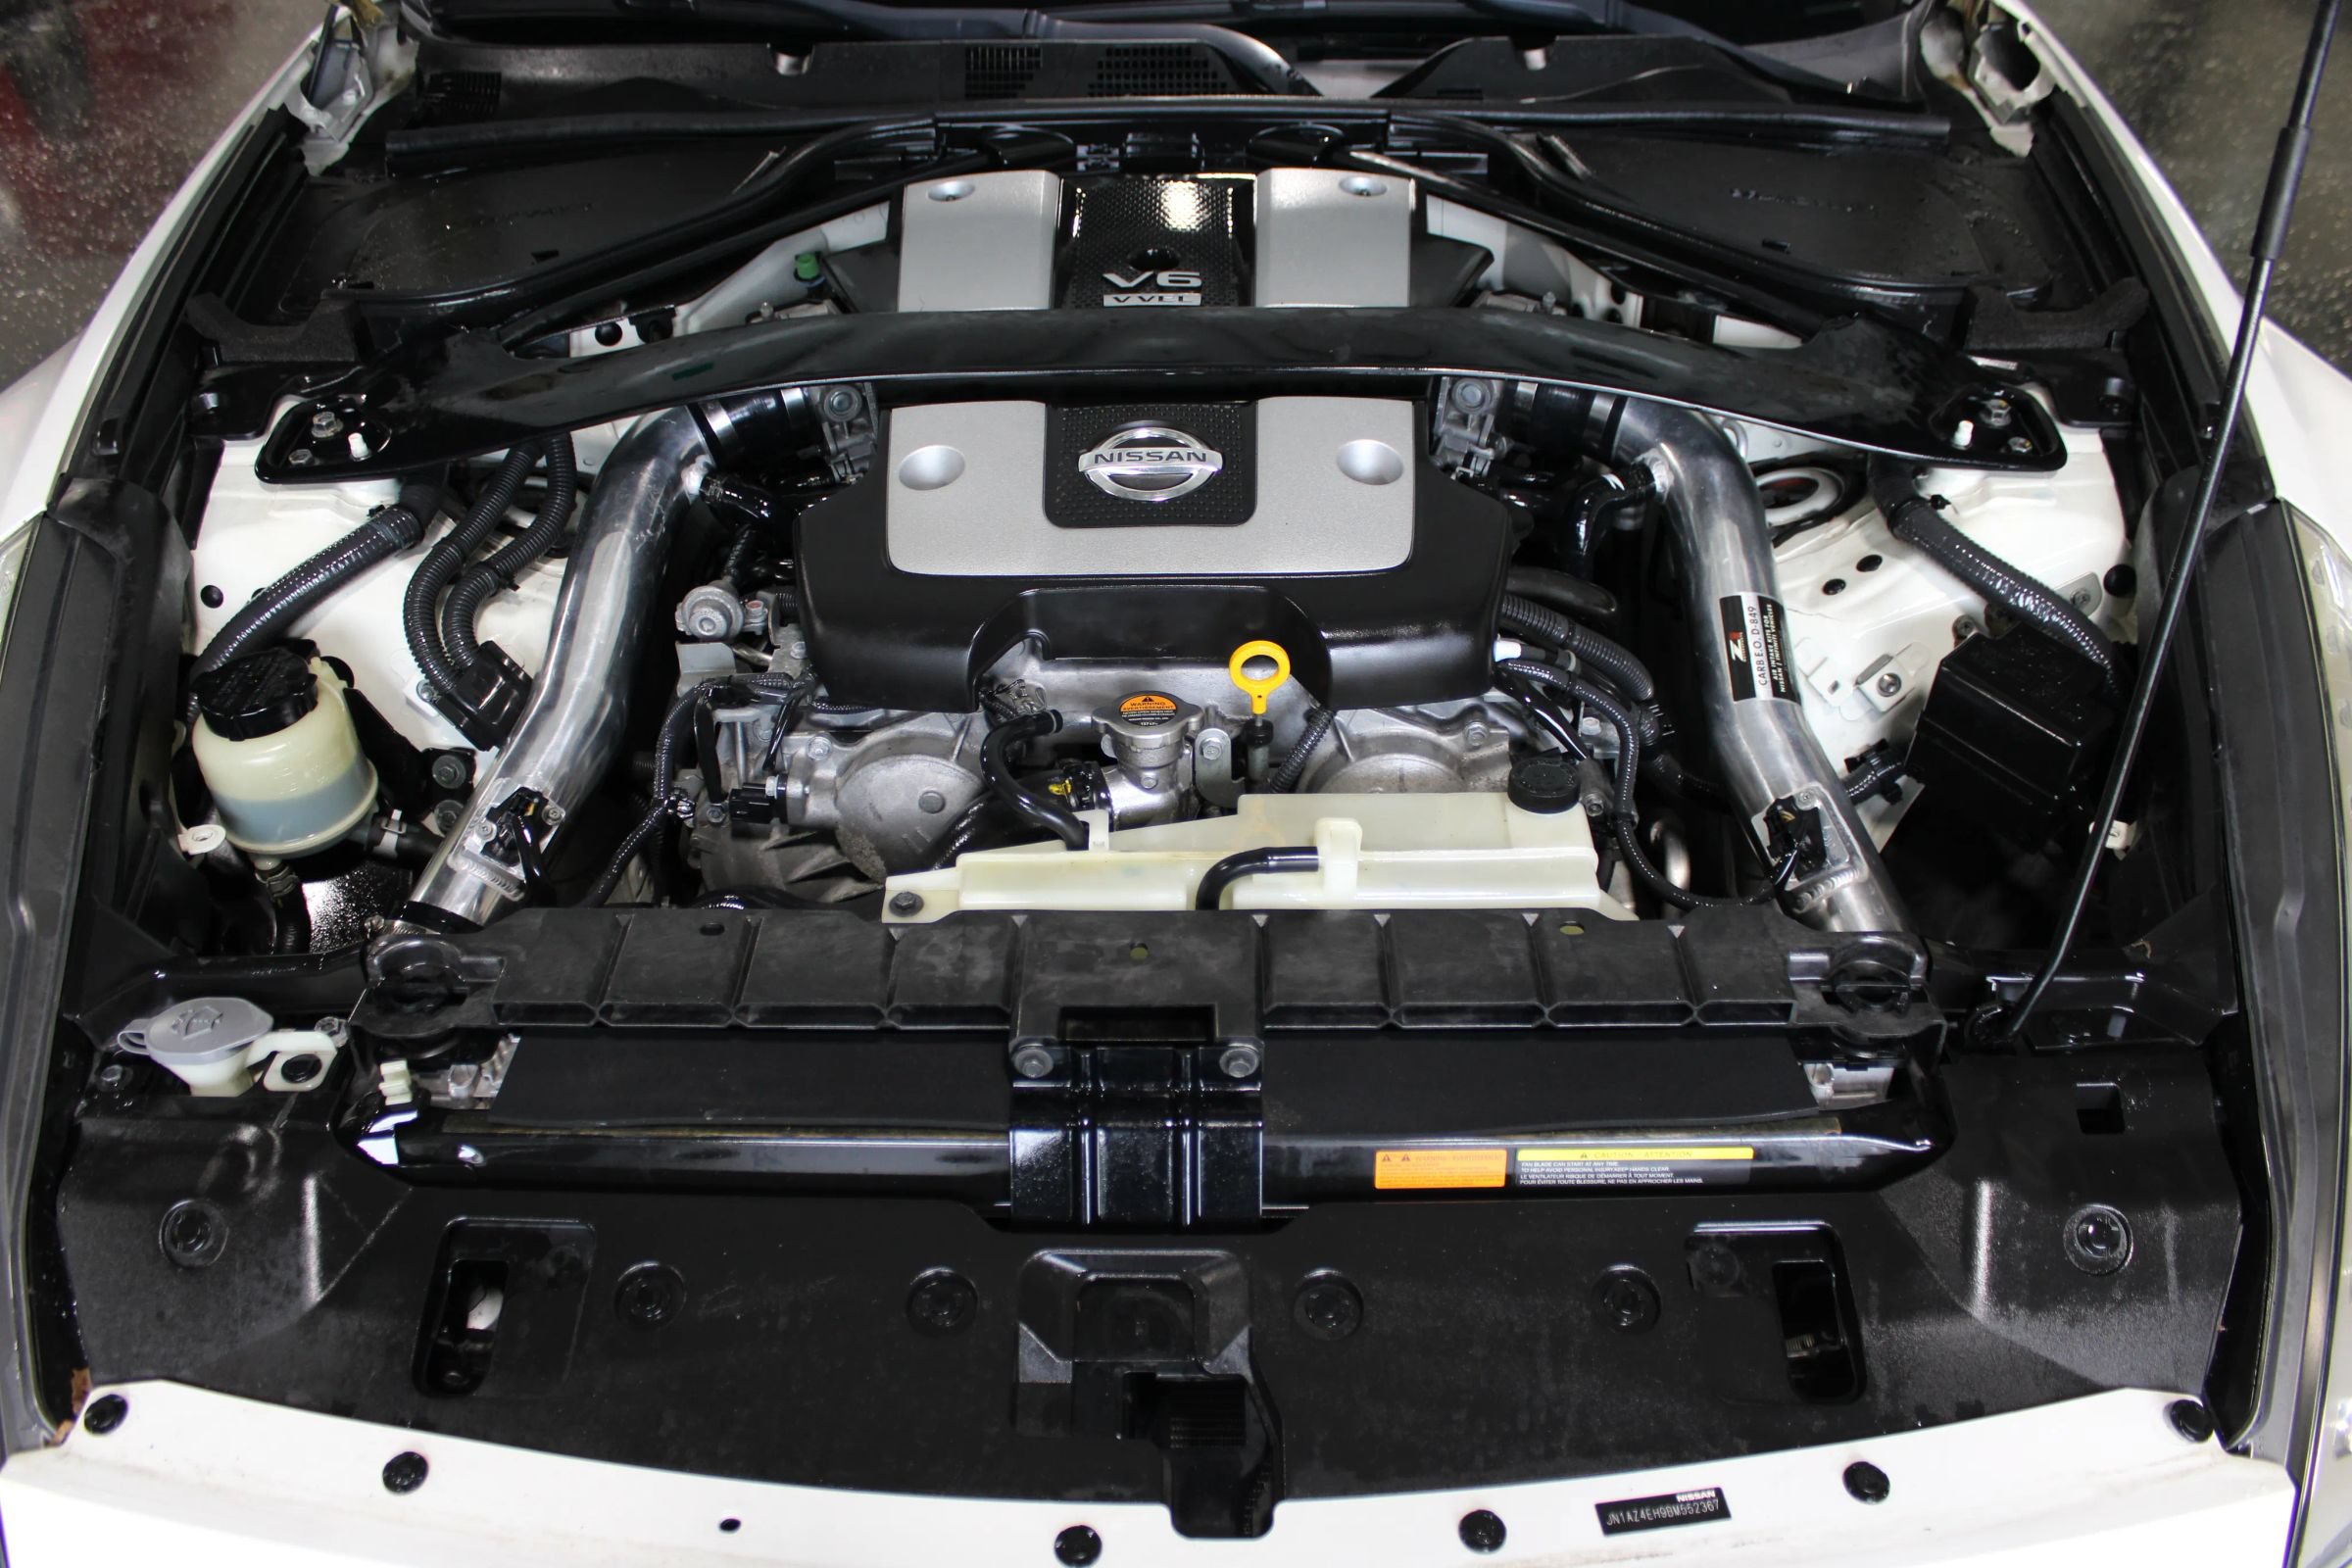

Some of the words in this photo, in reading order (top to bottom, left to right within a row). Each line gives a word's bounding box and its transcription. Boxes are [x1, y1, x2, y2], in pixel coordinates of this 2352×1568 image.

[1102, 270, 1203, 288] V6
[1094, 450, 1207, 465] NISSAN
[1747, 606, 1760, 635] D-849
[1766, 604, 1777, 633] VEHICLES
[1767, 644, 1777, 667] INTAKE
[1755, 660, 1768, 686] CARB
[1777, 667, 1787, 693] NISSAN
[1676, 1490, 1716, 1502] NISSAN
